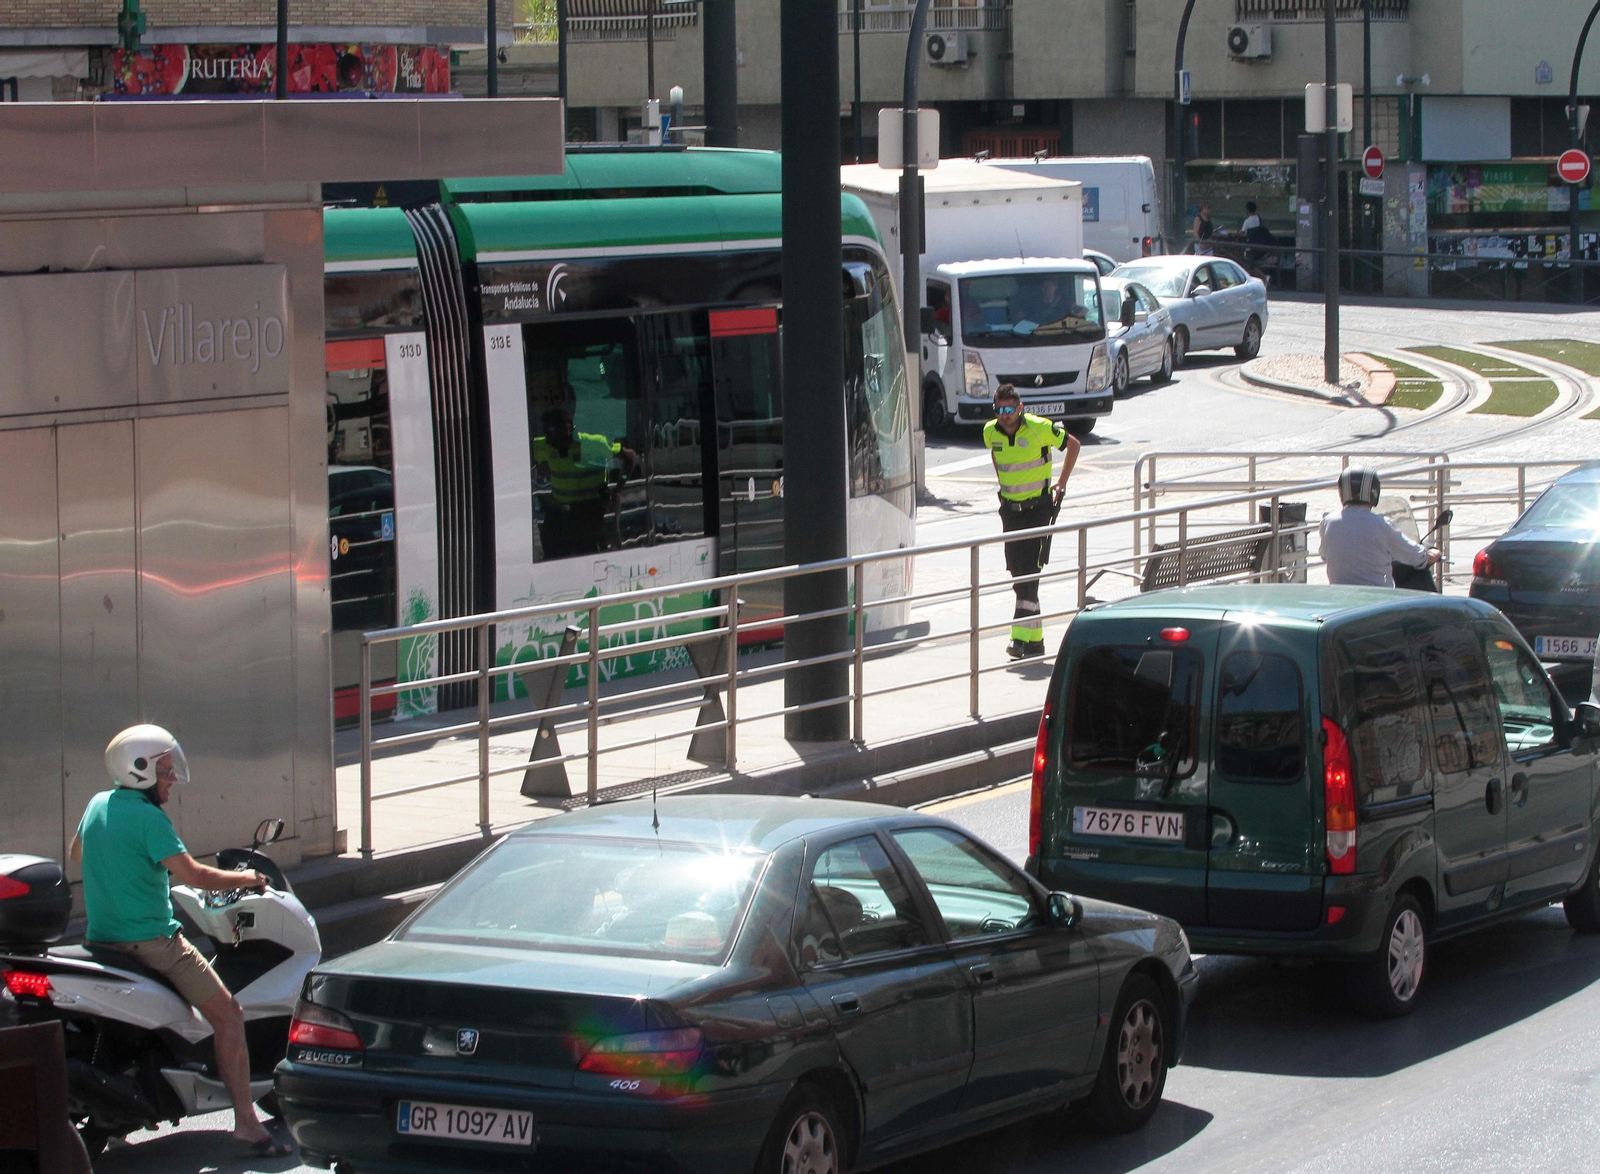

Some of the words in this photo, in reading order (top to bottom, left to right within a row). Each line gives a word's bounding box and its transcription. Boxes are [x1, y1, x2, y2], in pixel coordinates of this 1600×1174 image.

[481, 283, 510, 296] Transportes
[510, 281, 531, 293] Públicos
[532, 280, 539, 292] de
[503, 294, 540, 311] Andalucía
[141, 301, 284, 375] Villarejo
[490, 336, 505, 350] 313
[506, 335, 511, 348] E
[400, 344, 415, 359] 313
[416, 343, 422, 357] D
[1546, 639, 1579, 654] 1566
[1085, 810, 1136, 834] 7676
[1141, 814, 1180, 837] FVN
[298, 1050, 352, 1065] PEUGEOT
[609, 1079, 642, 1091] 406
[411, 1105, 438, 1132] GR
[446, 1108, 499, 1137] 1097
[502, 1113, 531, 1141] AV
